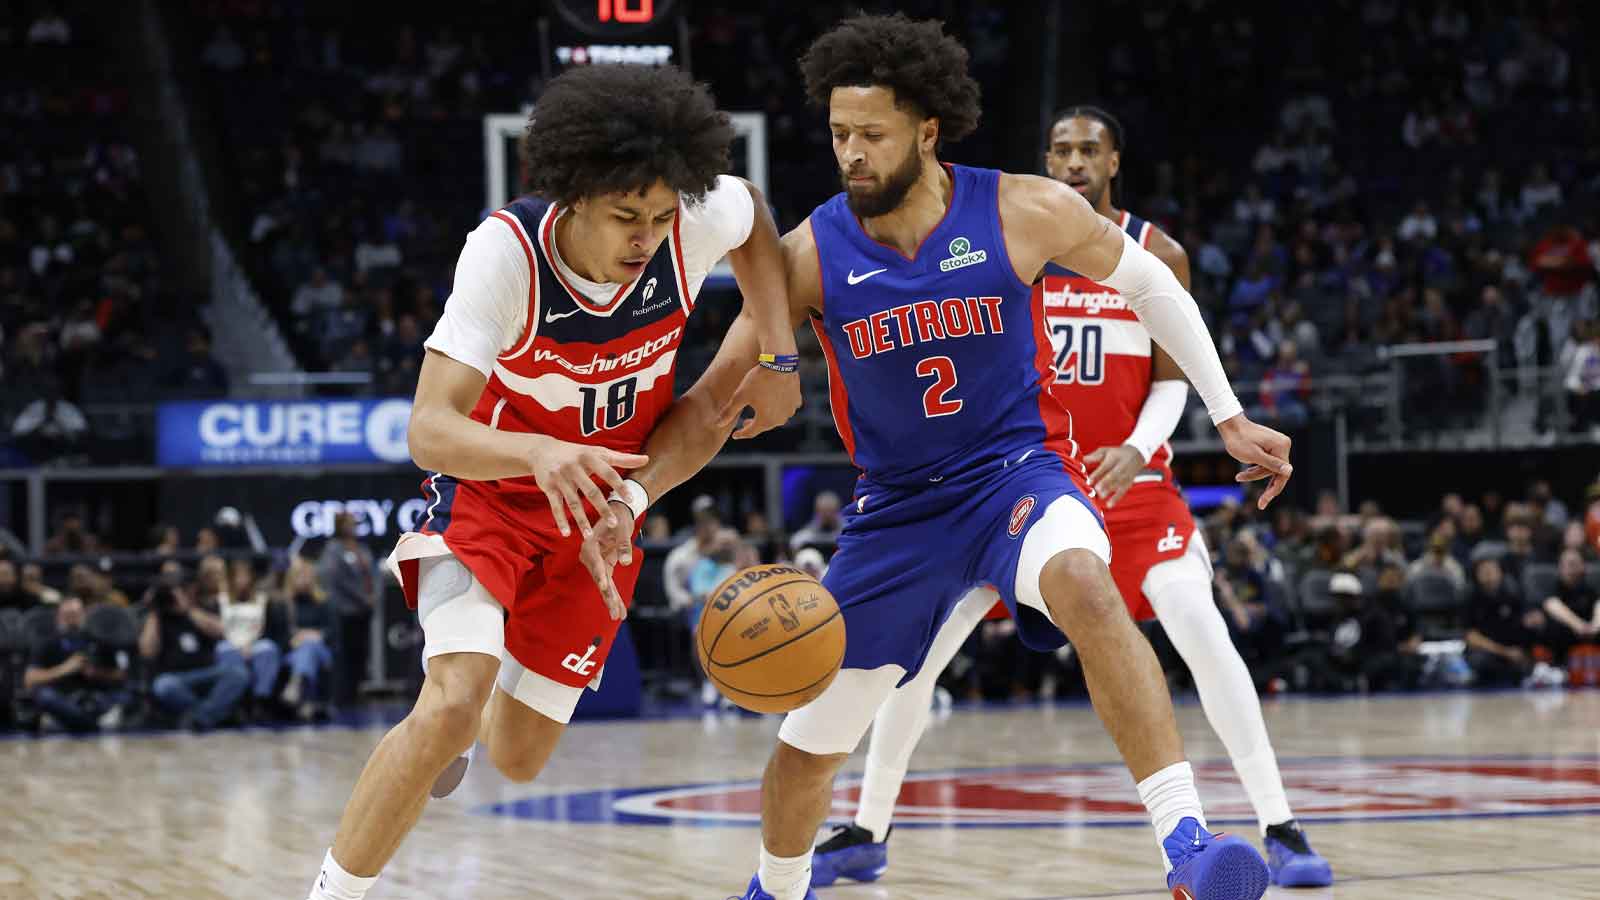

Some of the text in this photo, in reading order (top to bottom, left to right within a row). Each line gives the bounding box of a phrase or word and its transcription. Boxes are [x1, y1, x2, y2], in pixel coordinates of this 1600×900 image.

[941, 251, 986, 270] StockX
[632, 296, 672, 317] Robinhood
[842, 296, 1003, 360] DETROIT
[1051, 323, 1105, 386] 20
[578, 375, 638, 438] 18
[915, 355, 963, 418] 2
[200, 403, 364, 448] CURE
[561, 644, 598, 676] dc
